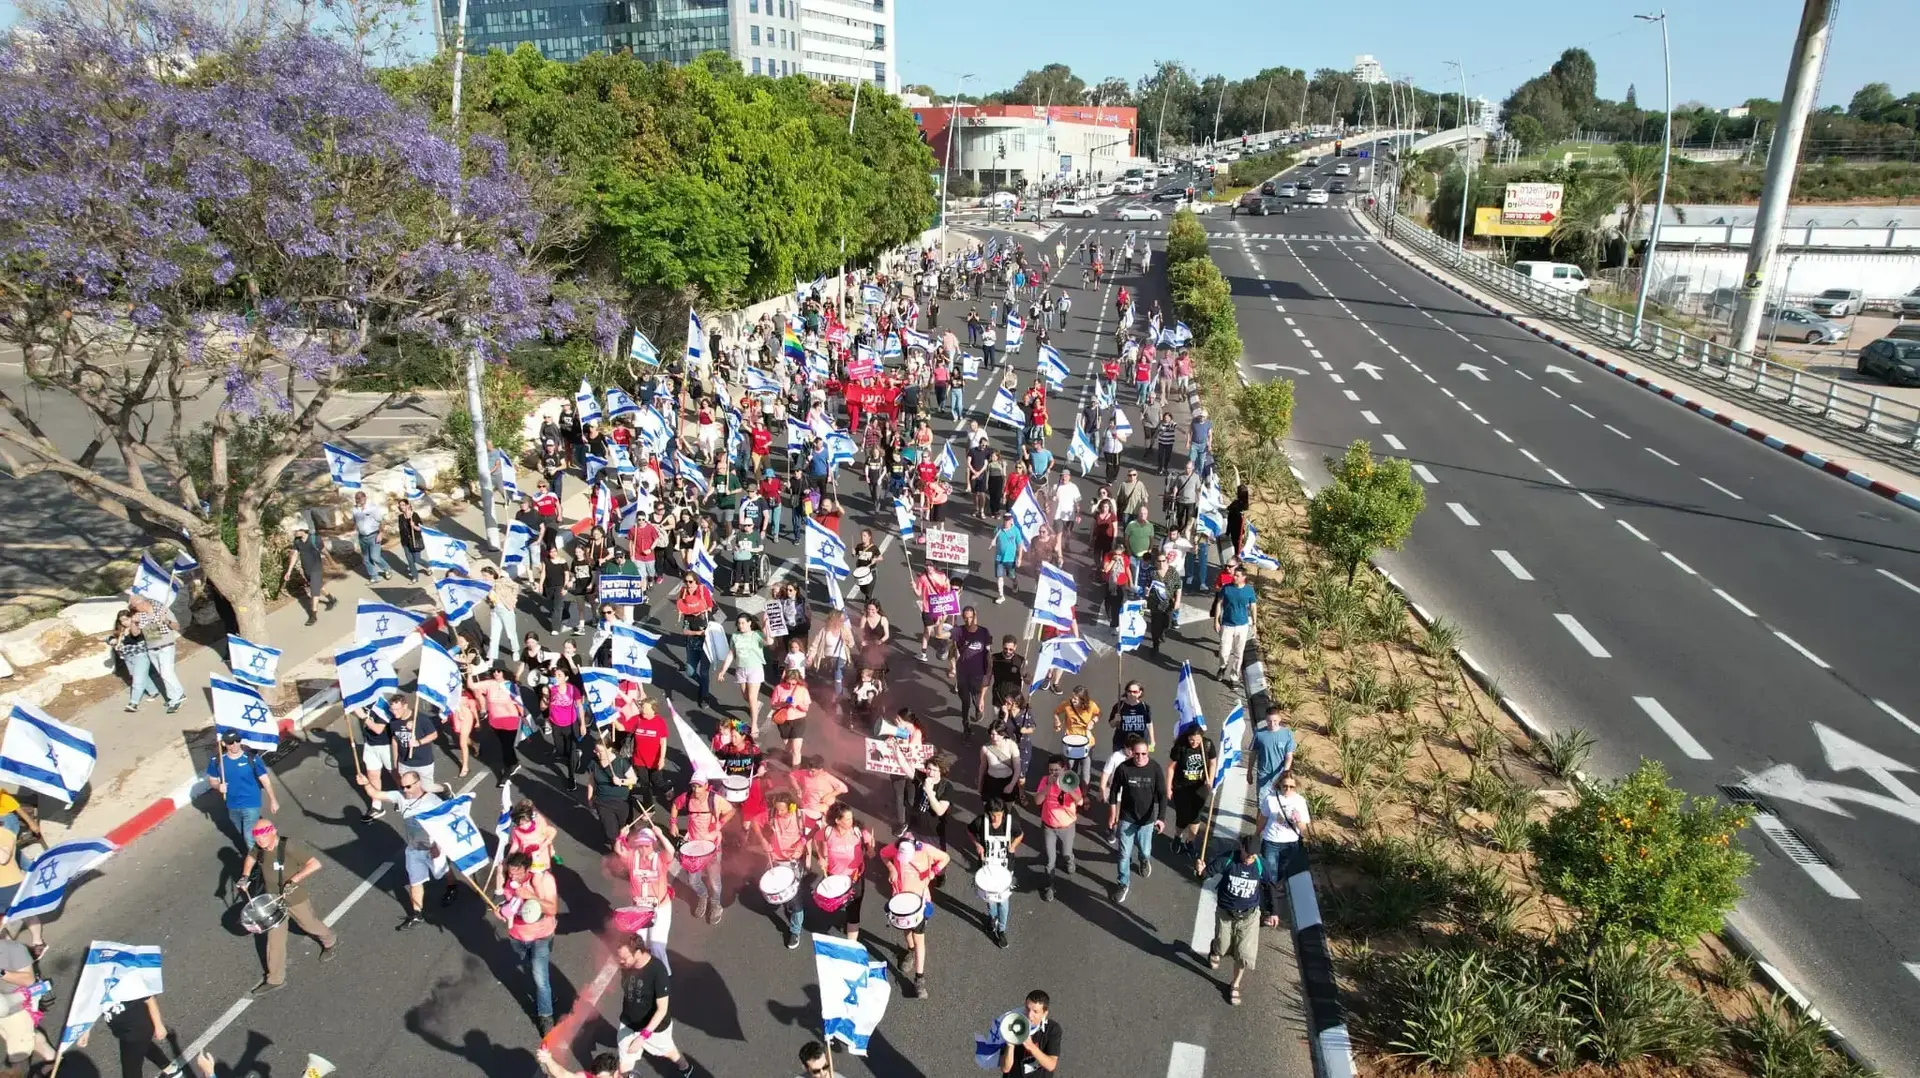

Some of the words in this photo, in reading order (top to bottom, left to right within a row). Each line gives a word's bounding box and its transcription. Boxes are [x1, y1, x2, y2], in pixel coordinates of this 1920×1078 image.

[941, 533, 956, 543] ימין
[1122, 715, 1144, 724] חופשי
[1229, 875, 1258, 889] חופשי
